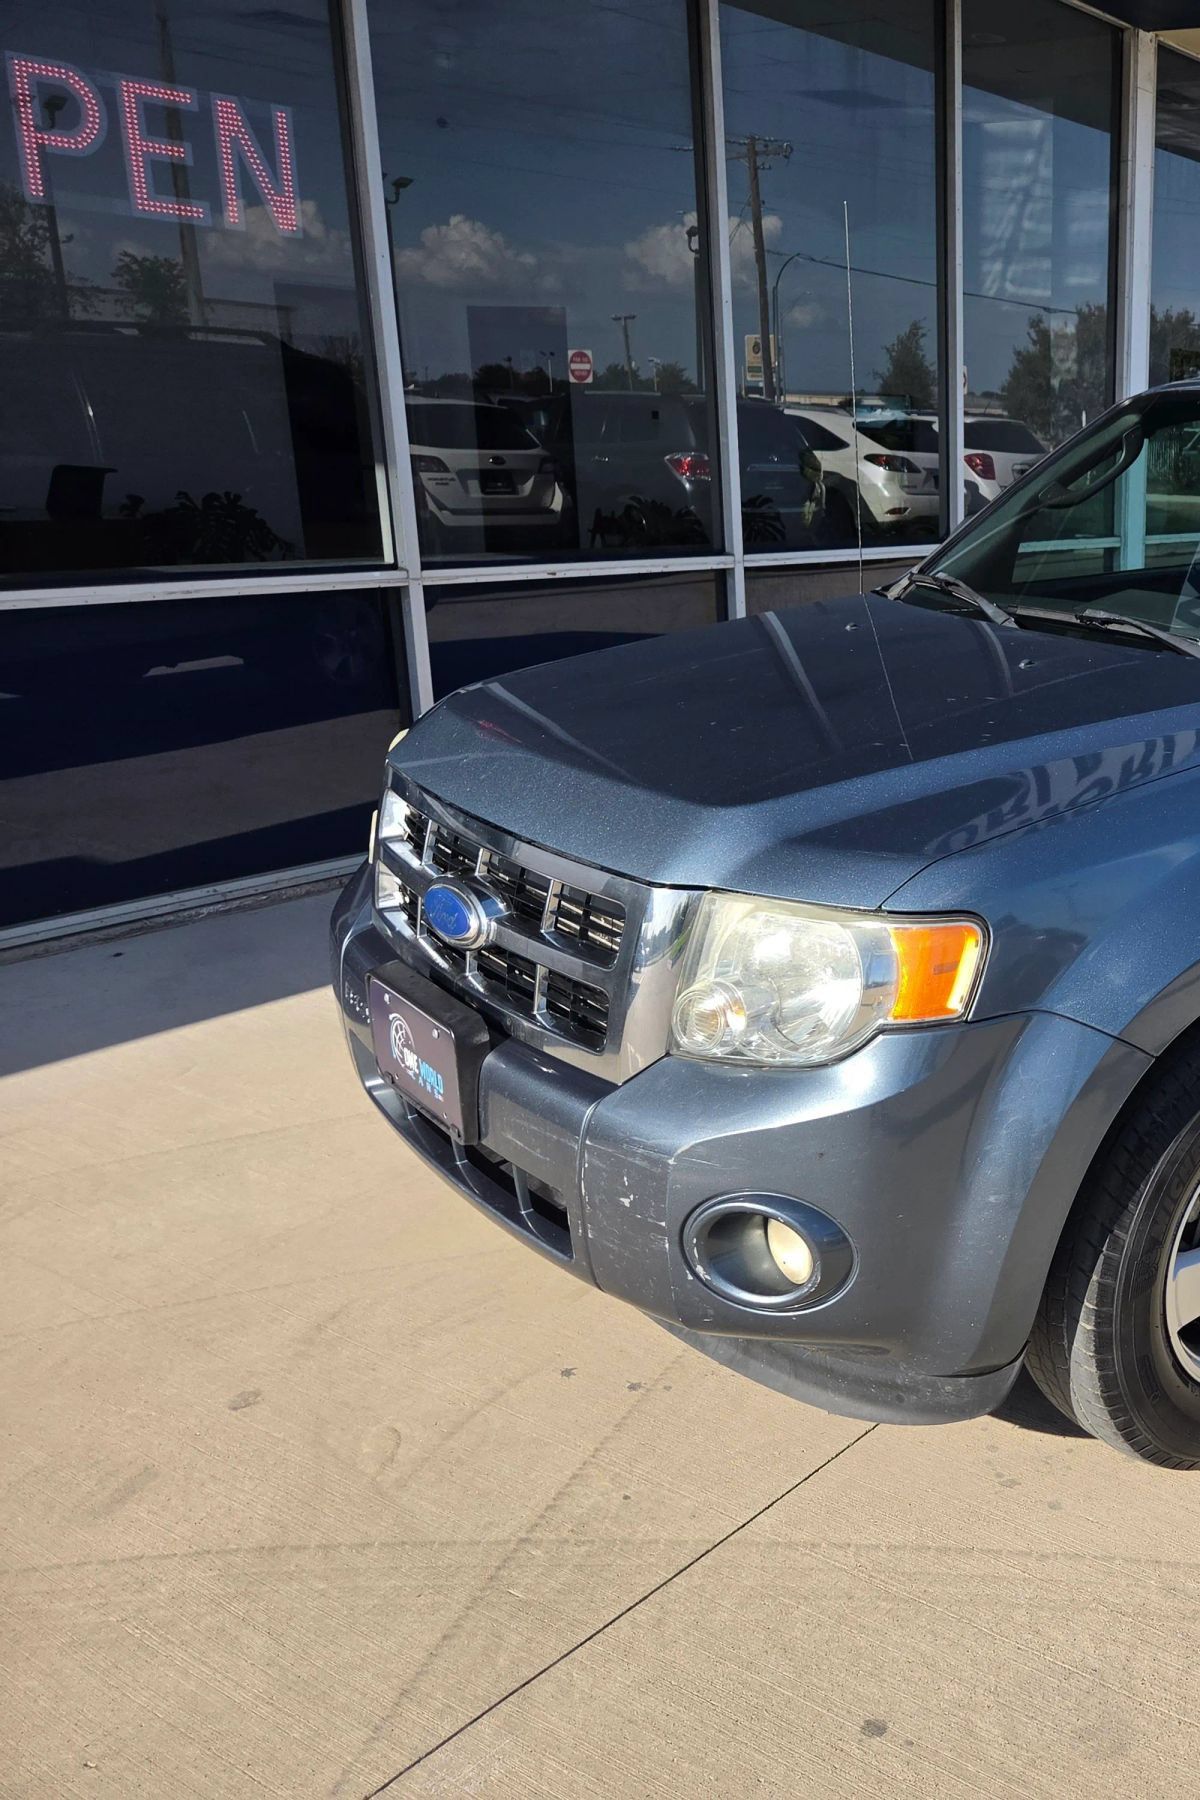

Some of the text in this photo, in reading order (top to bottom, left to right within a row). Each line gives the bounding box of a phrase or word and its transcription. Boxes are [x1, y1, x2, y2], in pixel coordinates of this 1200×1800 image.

[11, 57, 299, 232] PEN
[429, 894, 460, 930] Ford
[403, 1047, 444, 1095] ONE WORLD
